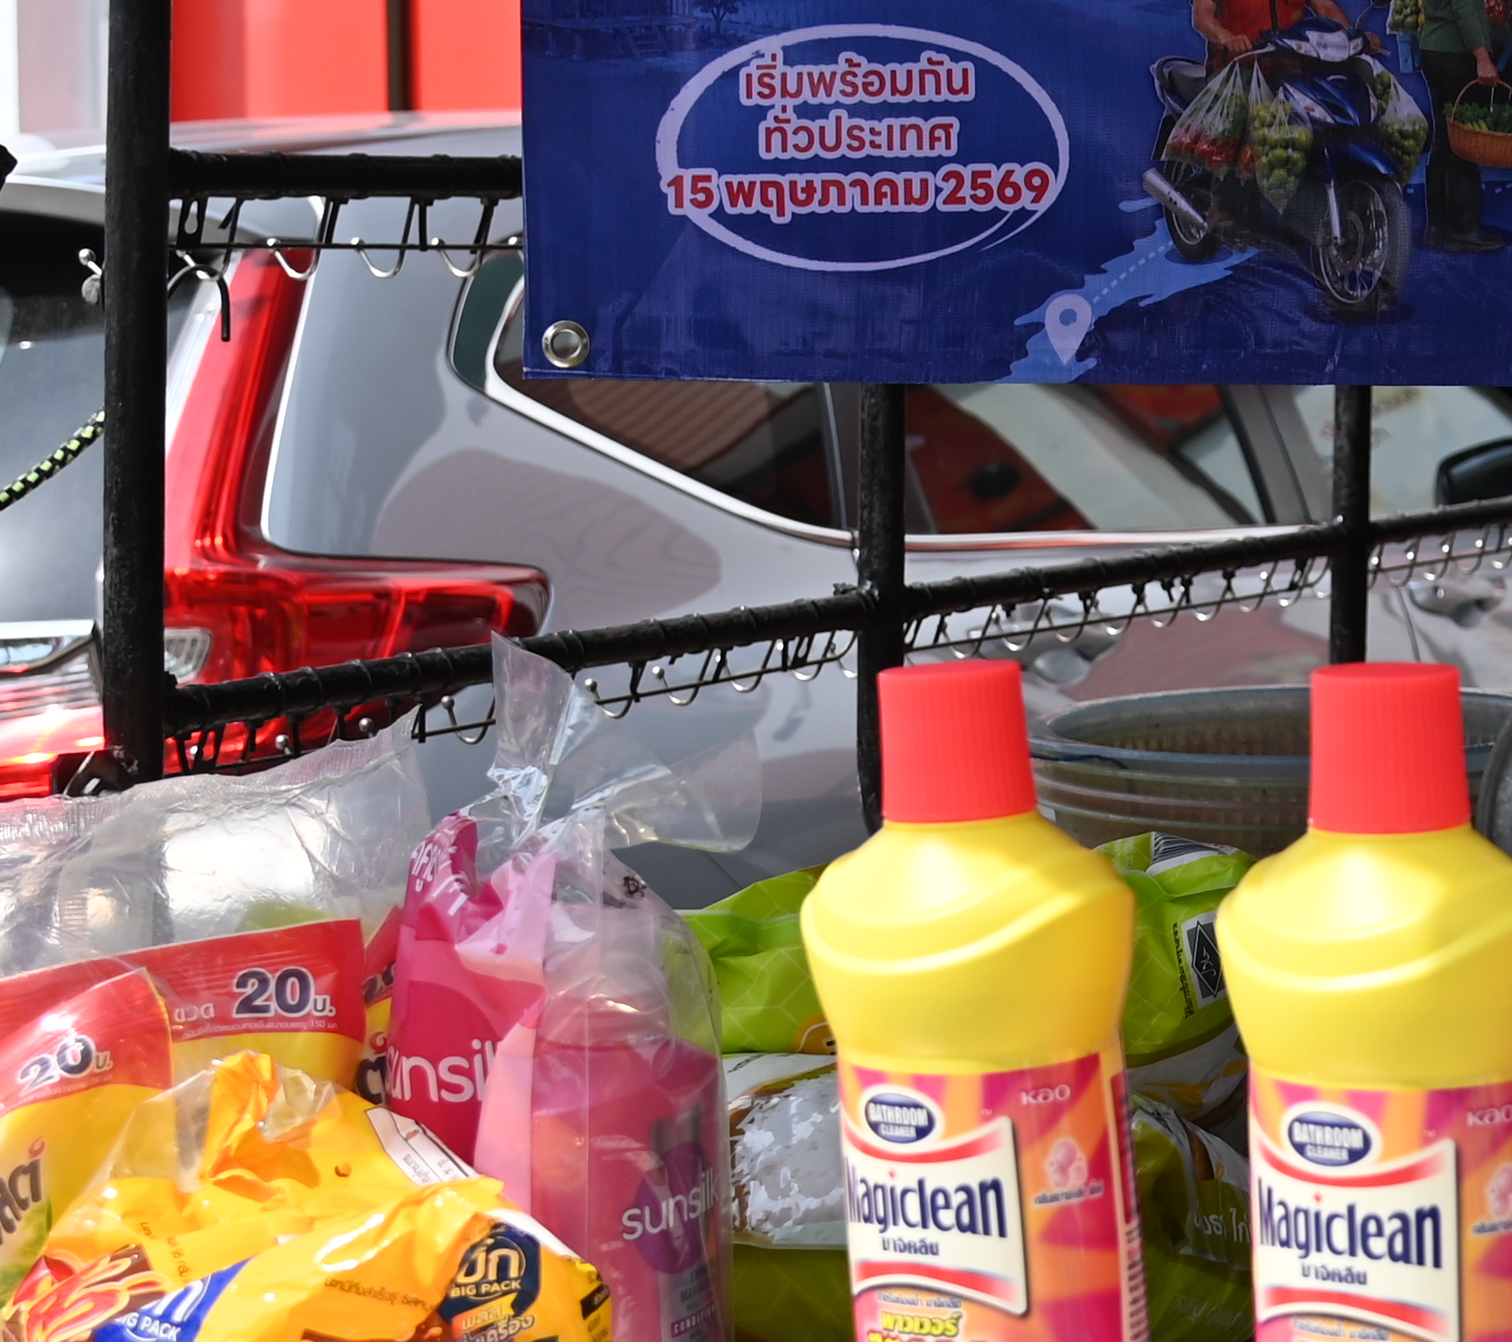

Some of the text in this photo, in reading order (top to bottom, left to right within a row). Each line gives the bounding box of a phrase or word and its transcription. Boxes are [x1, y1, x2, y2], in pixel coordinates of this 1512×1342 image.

[744, 53, 970, 100] เริ่มพร้อมกัน
[764, 105, 955, 153] ทั่วประเทศ
[667, 168, 1050, 219] 15 พฤษภาคม 2569
[234, 967, 314, 1018] 20
[313, 996, 336, 1016] บ.
[19, 1035, 96, 1096] 20
[869, 1103, 929, 1127] BATHROOM
[880, 1122, 916, 1138] CLEANER
[1292, 1123, 1364, 1149] BATHROOM
[1304, 1145, 1348, 1160] CLEANER
[849, 1162, 1007, 1238] Magiclean
[1258, 1177, 1442, 1269] Magiclean
[451, 1280, 521, 1298] BIG PACK
[140, 1318, 181, 1341] PACK
[882, 1310, 961, 1337] พาวเวอร์
